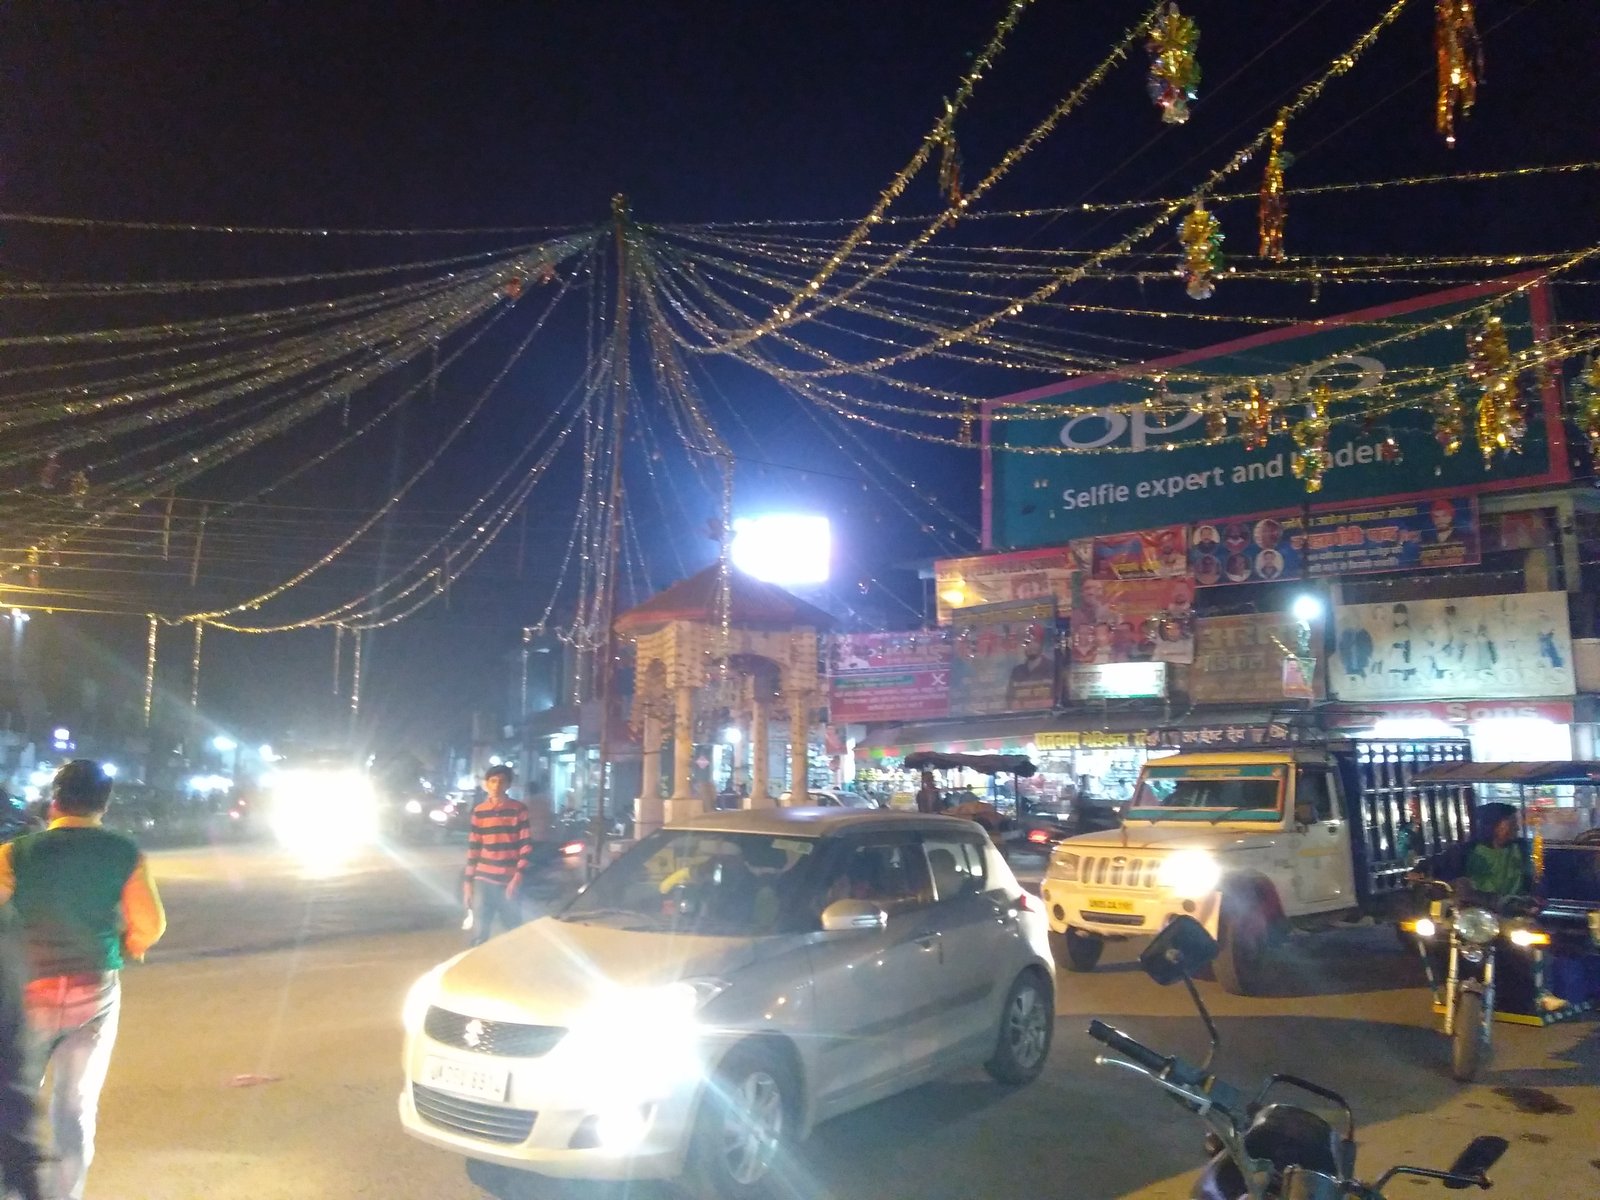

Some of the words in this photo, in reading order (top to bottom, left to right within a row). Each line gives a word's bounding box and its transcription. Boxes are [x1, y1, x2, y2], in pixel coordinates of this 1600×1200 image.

[1062, 477, 1131, 512] Selfie
[1136, 461, 1225, 500] expert
[1231, 454, 1284, 484] and
[1290, 441, 1390, 477] lader
